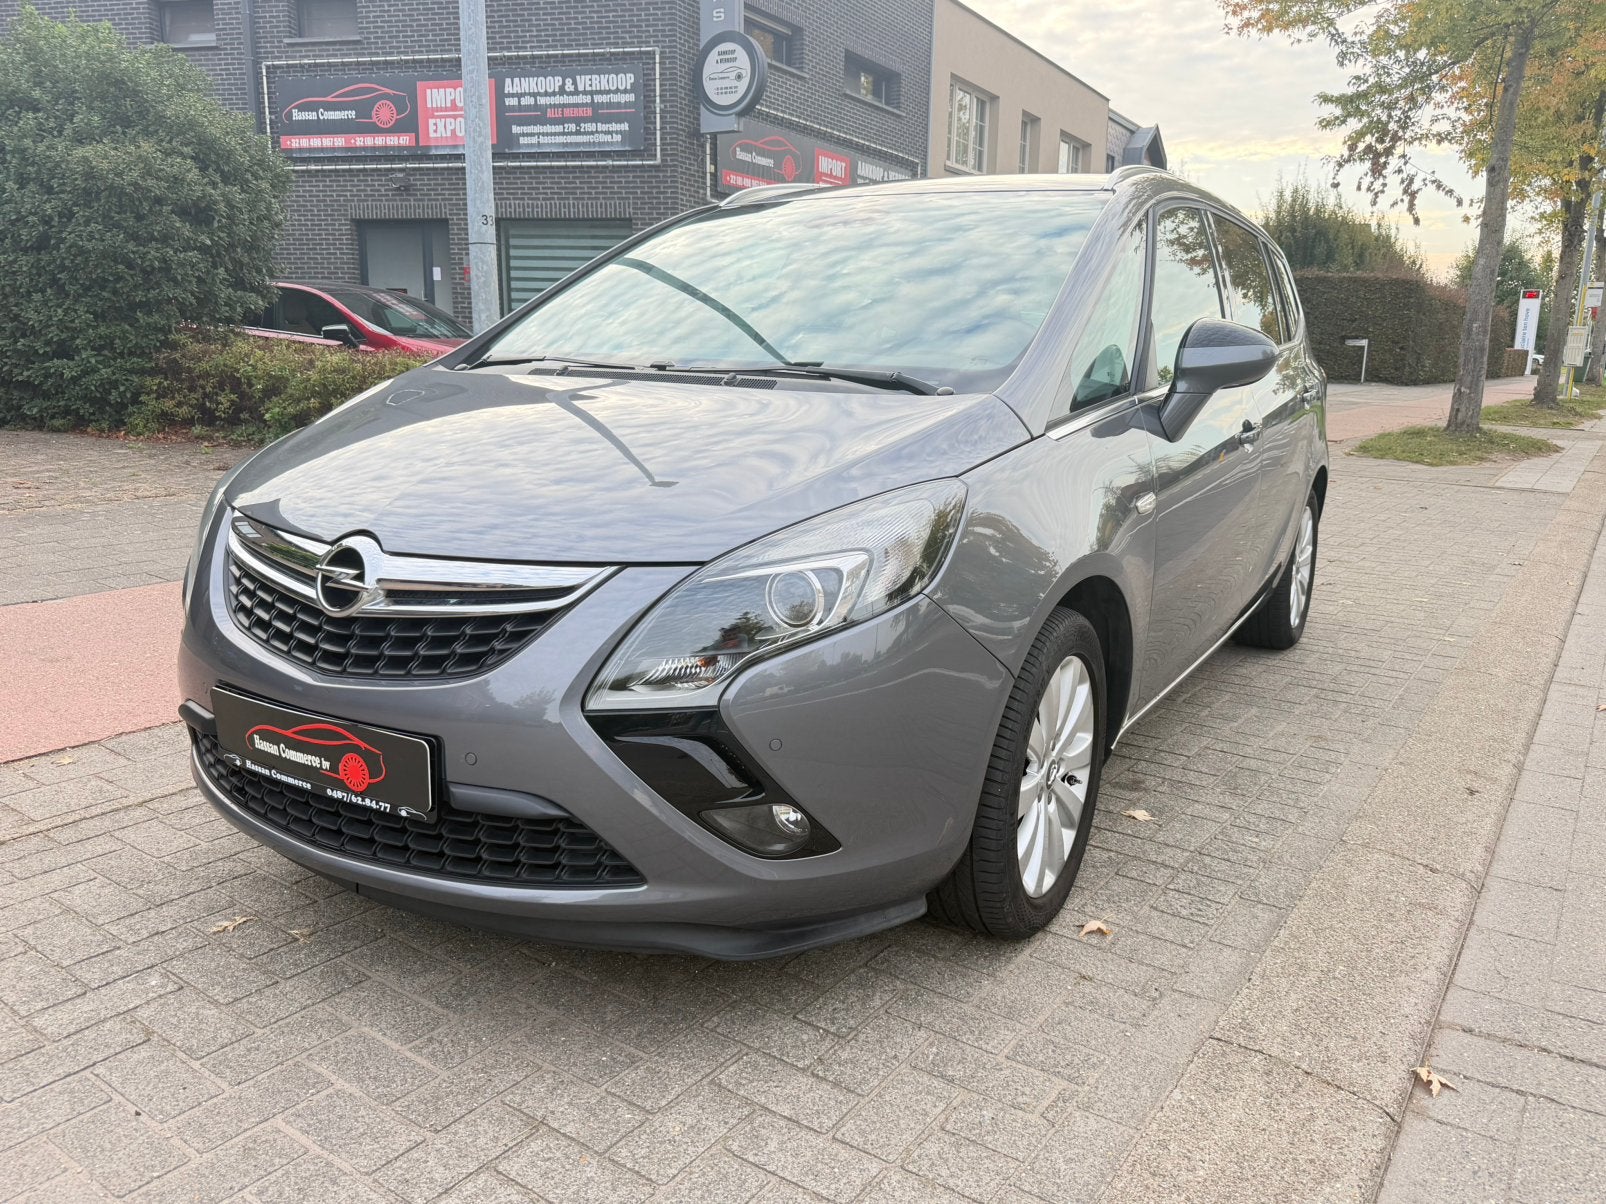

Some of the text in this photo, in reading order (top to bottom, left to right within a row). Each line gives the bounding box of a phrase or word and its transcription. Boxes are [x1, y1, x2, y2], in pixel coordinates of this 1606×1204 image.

[504, 73, 635, 94] AANKOOP & VERKOOP
[426, 87, 464, 108] IMPO
[505, 92, 635, 106] van alle tweedehandse voertuigen
[292, 108, 356, 120] Hassan Commerce
[547, 107, 593, 118] ALLE MERKEN
[428, 118, 465, 137] EXPO
[580, 122, 597, 132] 2150
[597, 121, 629, 132] Borsbeek
[818, 155, 846, 179] IMPORT
[857, 161, 884, 181] AANKOOP
[481, 214, 494, 226] 33
[254, 733, 331, 771] Hassan Commerce bv
[245, 759, 312, 790] Hassan Commerce
